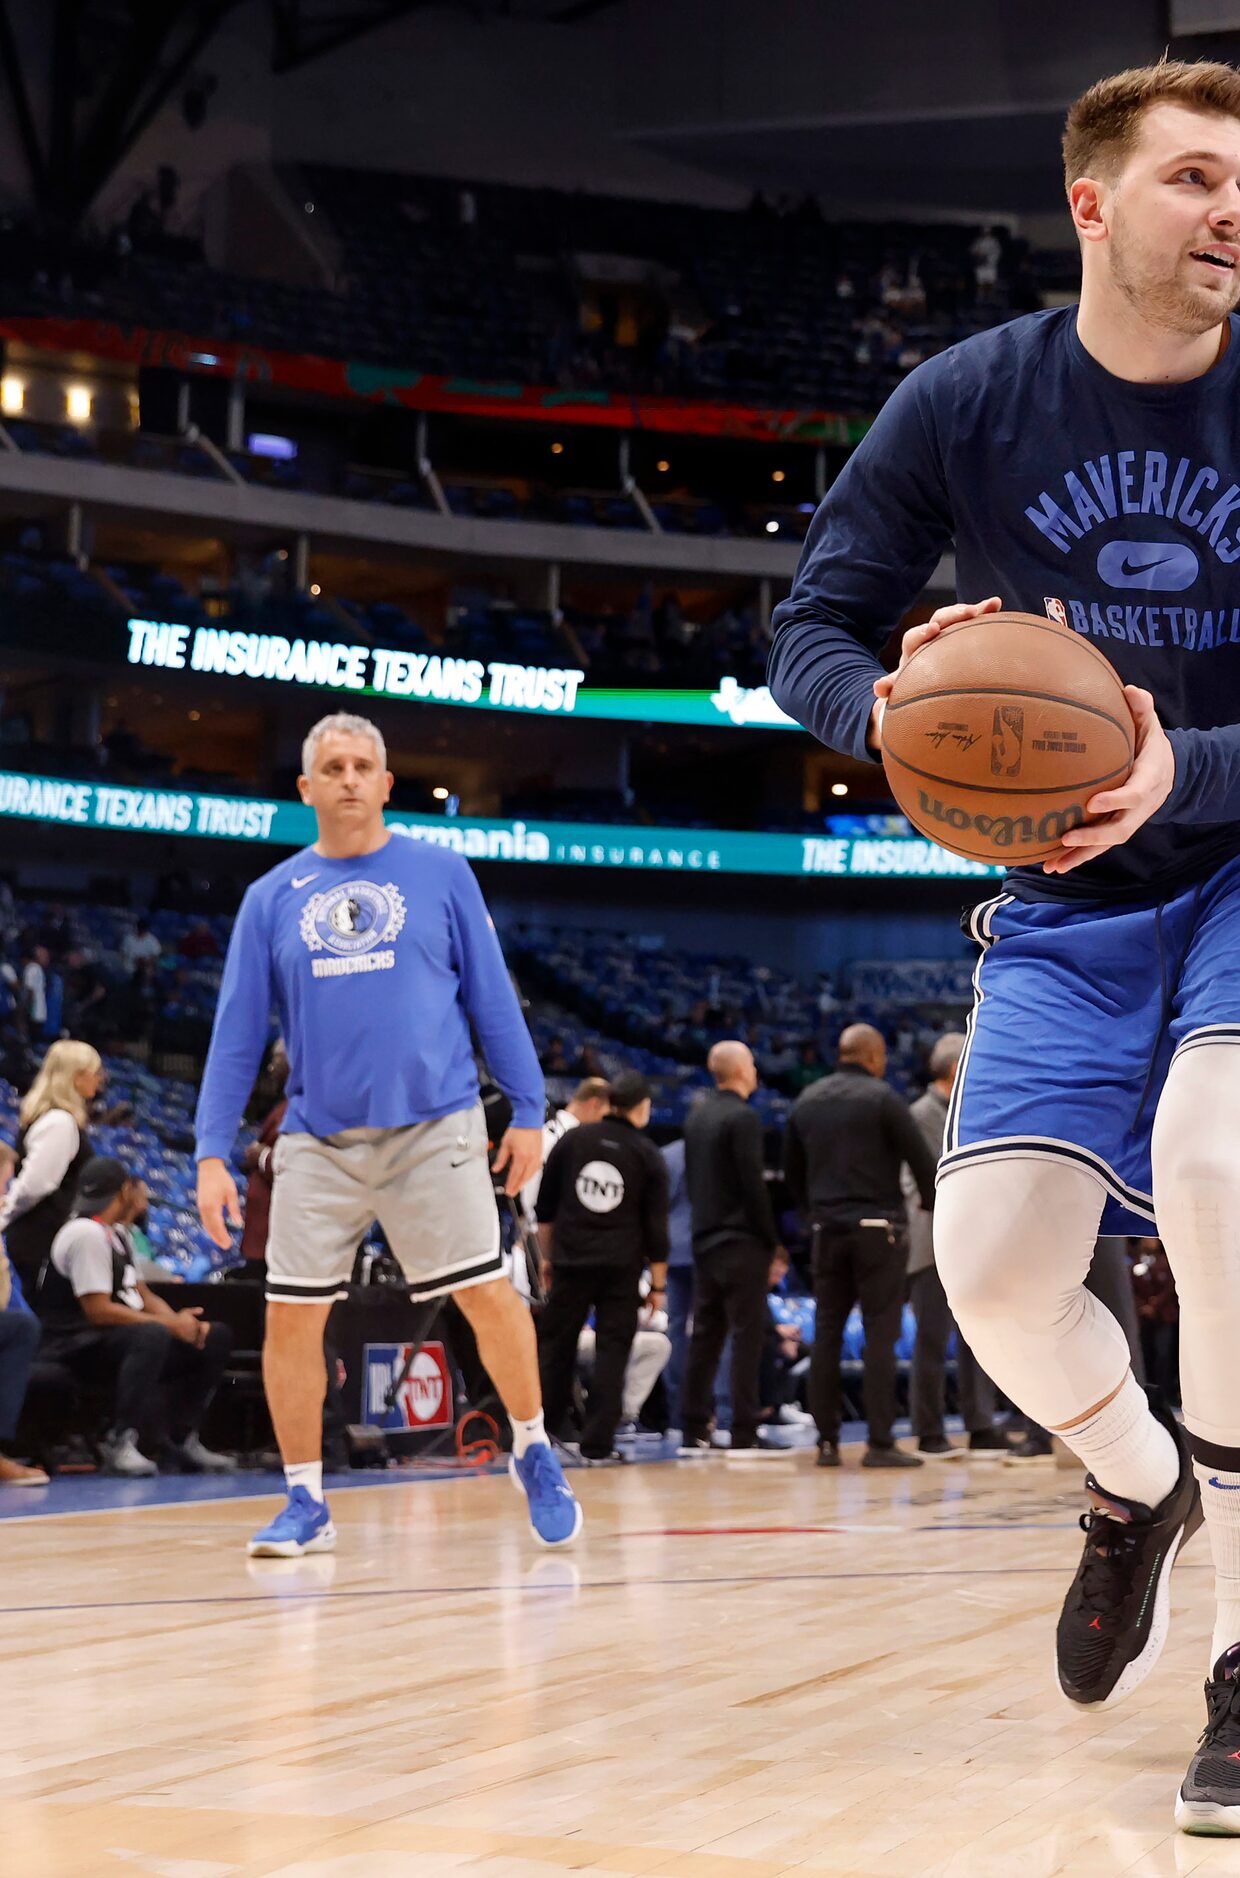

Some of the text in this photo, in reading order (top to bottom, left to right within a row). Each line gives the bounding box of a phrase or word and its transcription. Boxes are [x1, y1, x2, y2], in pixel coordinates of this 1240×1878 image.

[127, 618, 585, 712] THE INSURANCE TEXANS TRUST
[95, 787, 193, 832] TEXANS
[197, 797, 278, 839] TRUST
[916, 789, 1085, 847] Wilson
[555, 843, 721, 870] INSURANCE
[802, 837, 850, 874] THE
[578, 1174, 624, 1198] TNT
[403, 1375, 443, 1401] TNT
